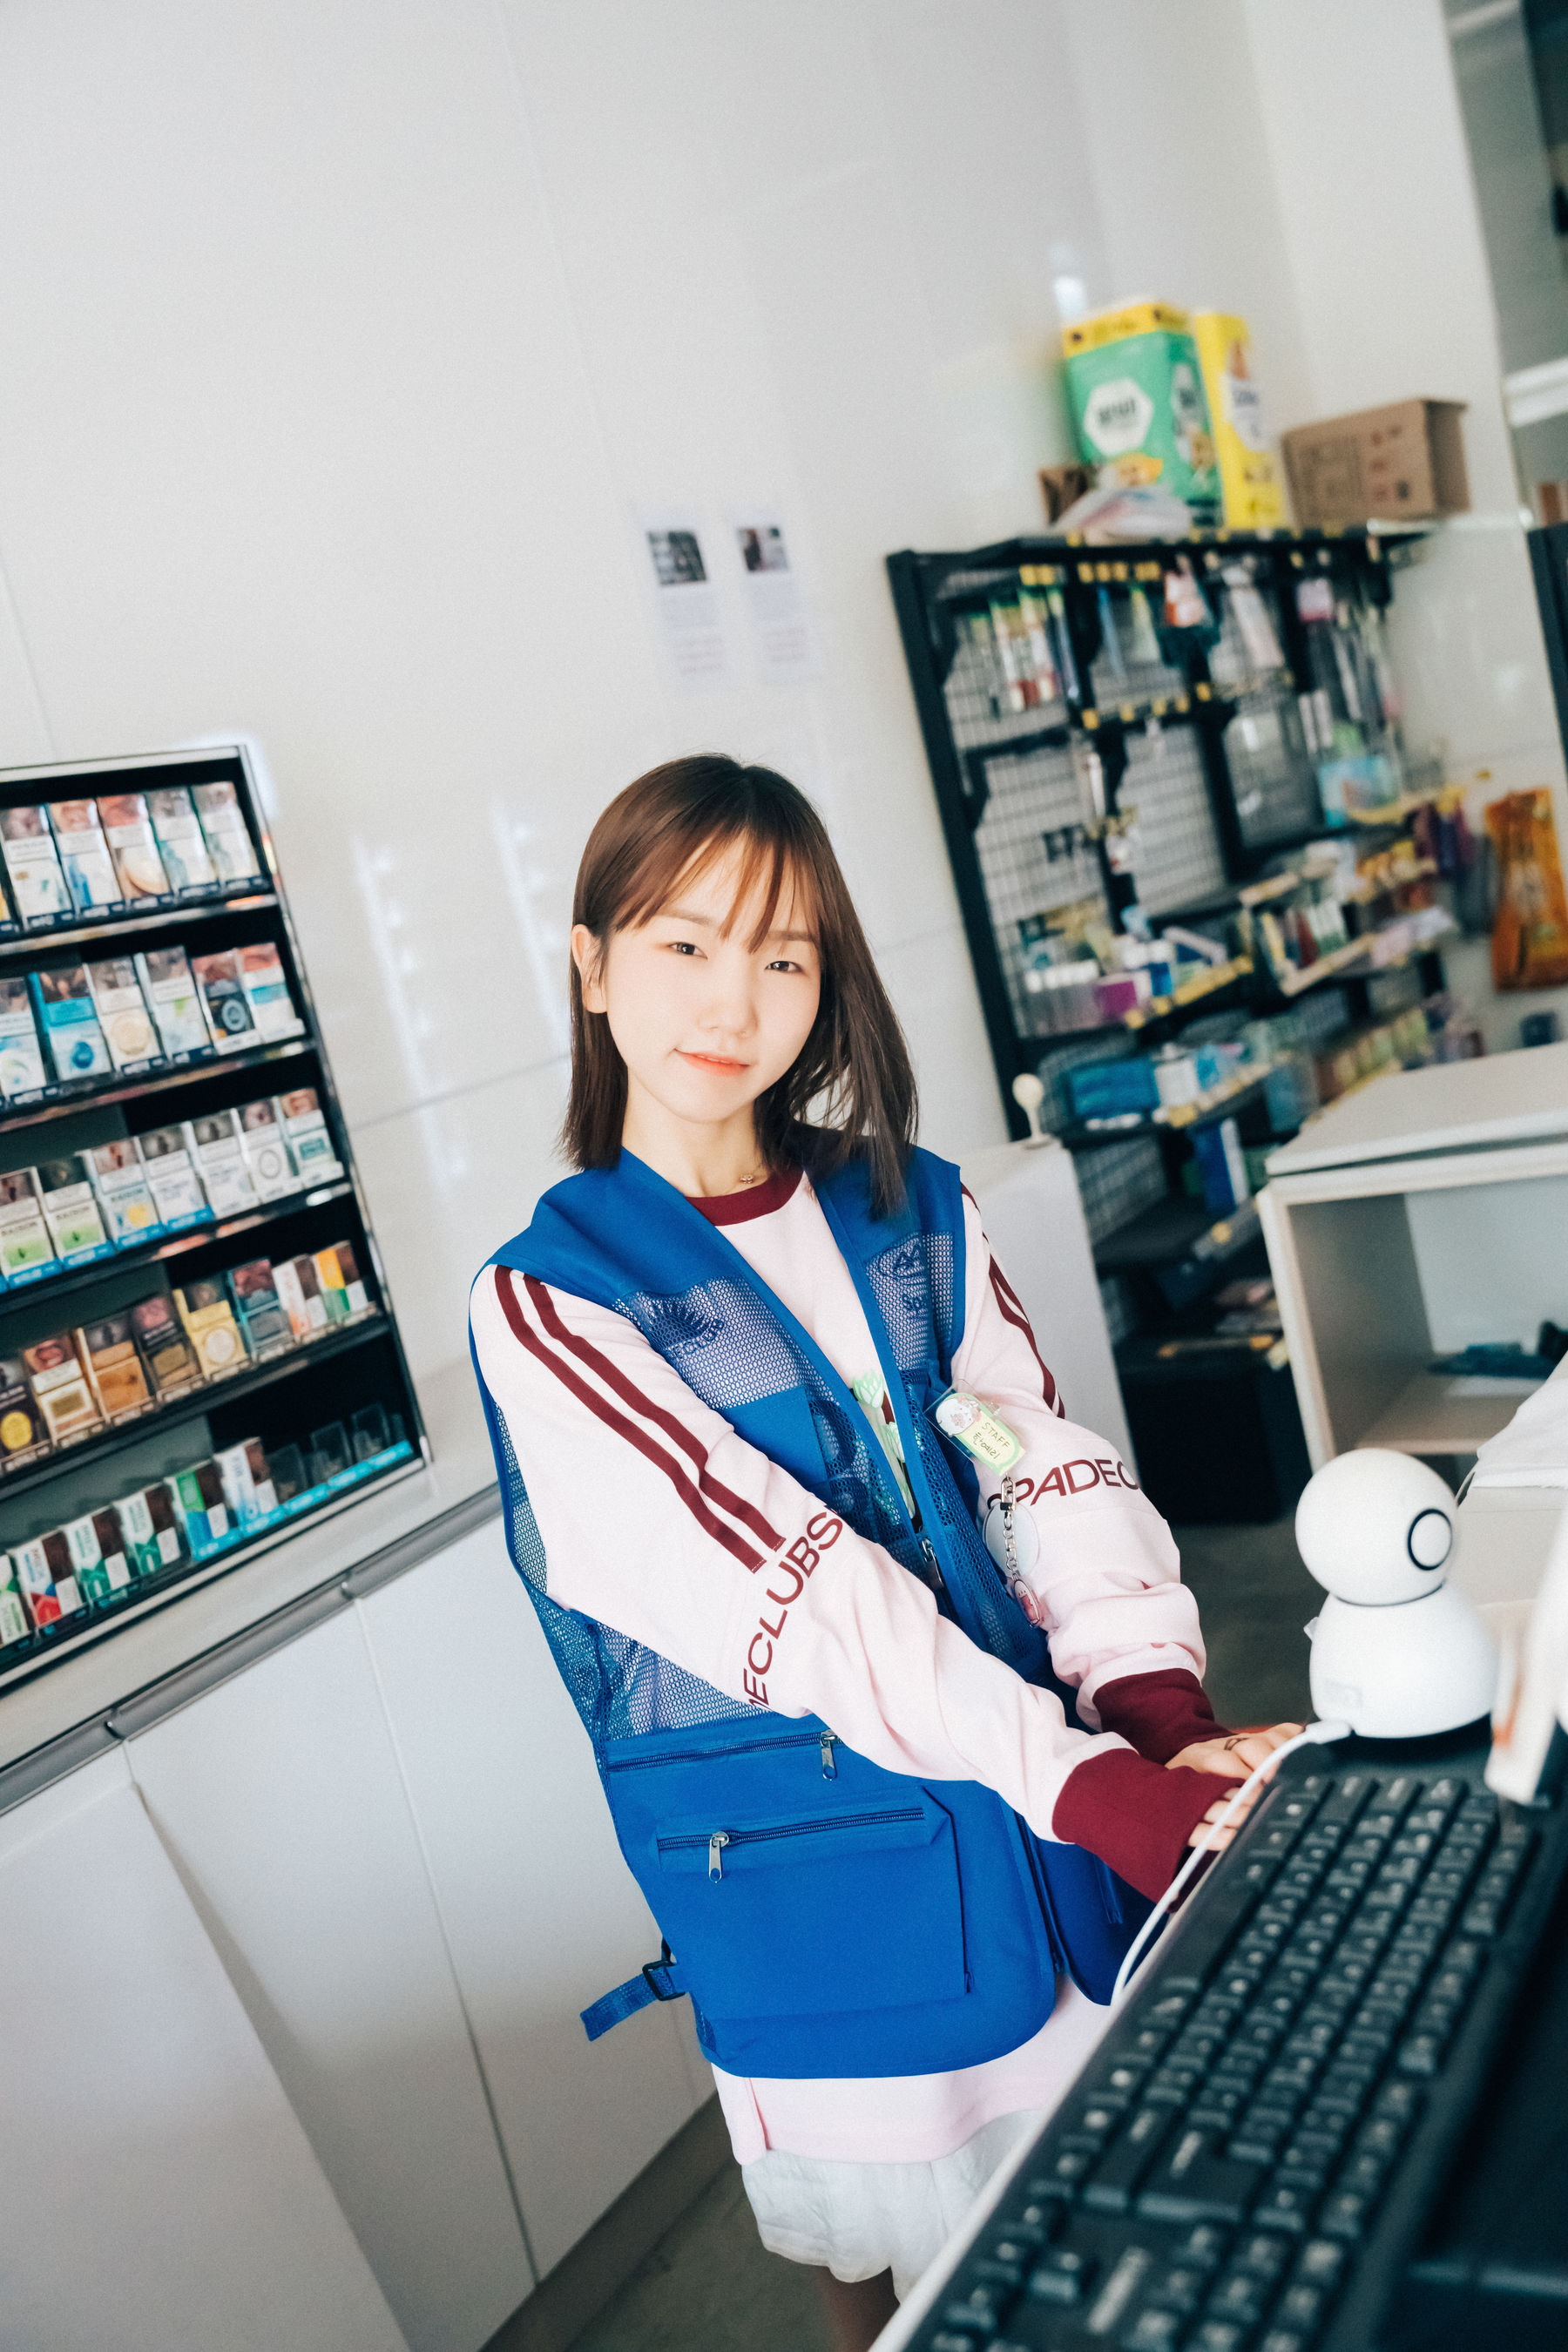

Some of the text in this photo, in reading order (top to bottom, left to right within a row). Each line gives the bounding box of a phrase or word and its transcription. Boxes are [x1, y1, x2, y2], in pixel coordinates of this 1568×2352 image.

[669, 1319, 725, 1360] ECLUB
[982, 1422, 1010, 1449] STAFF
[742, 1504, 844, 1711] ECLUBS
